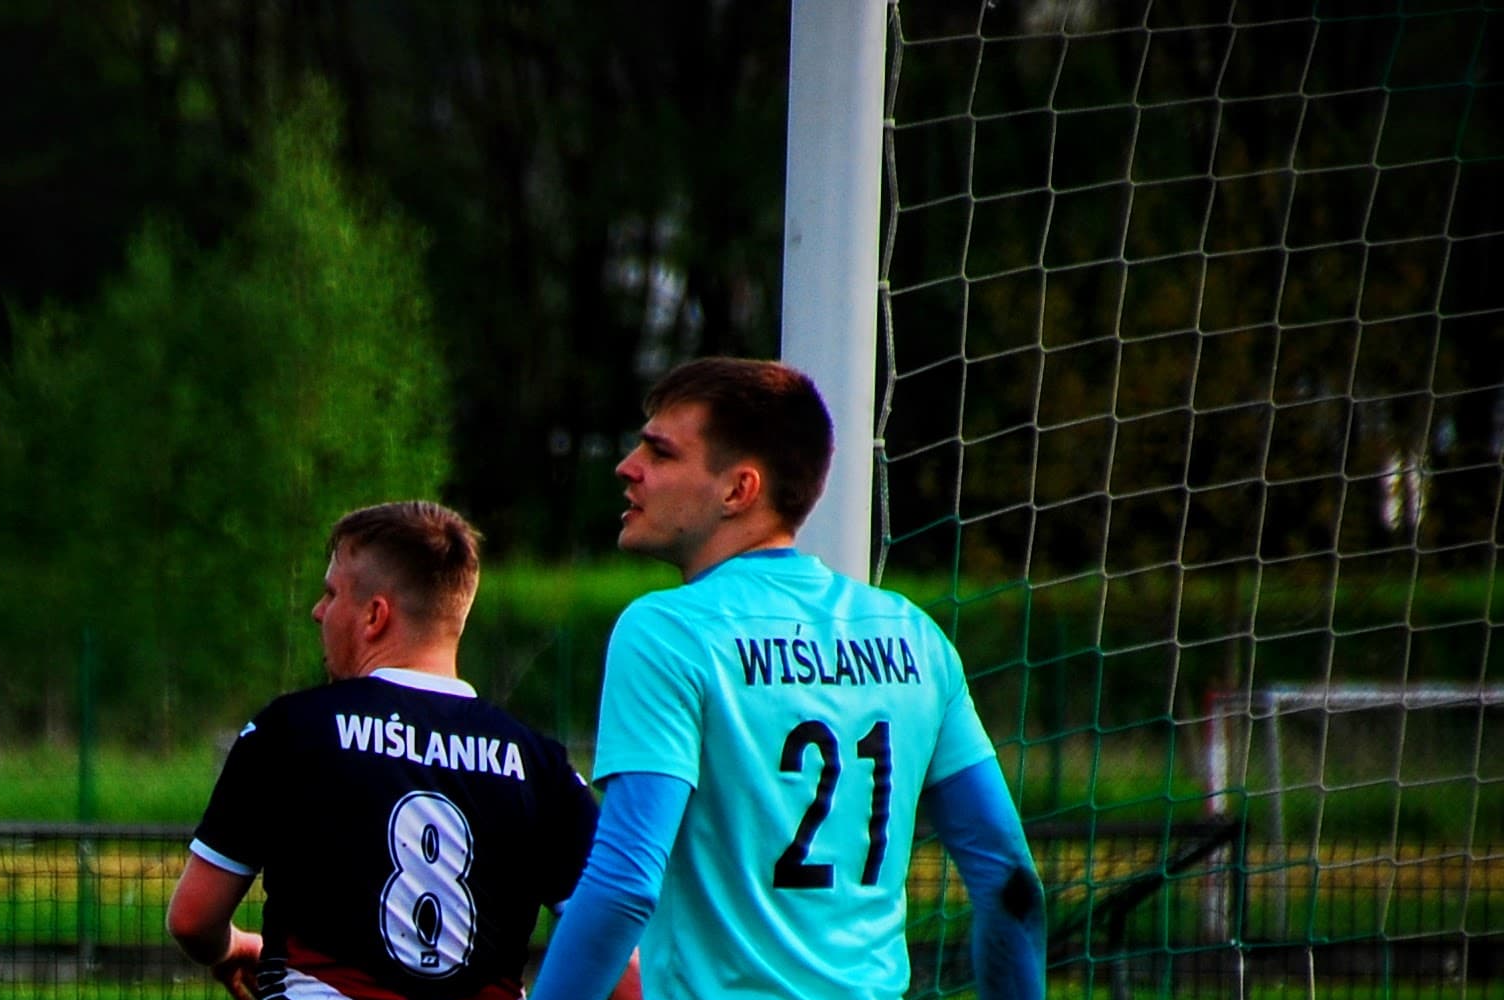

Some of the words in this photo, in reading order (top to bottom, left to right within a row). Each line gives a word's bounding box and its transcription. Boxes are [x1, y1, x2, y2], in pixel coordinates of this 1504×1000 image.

[737, 624, 920, 685] WIŚLANKA
[336, 713, 526, 780] WIŚLANKA
[773, 721, 892, 888] 21
[381, 790, 477, 977] 8
